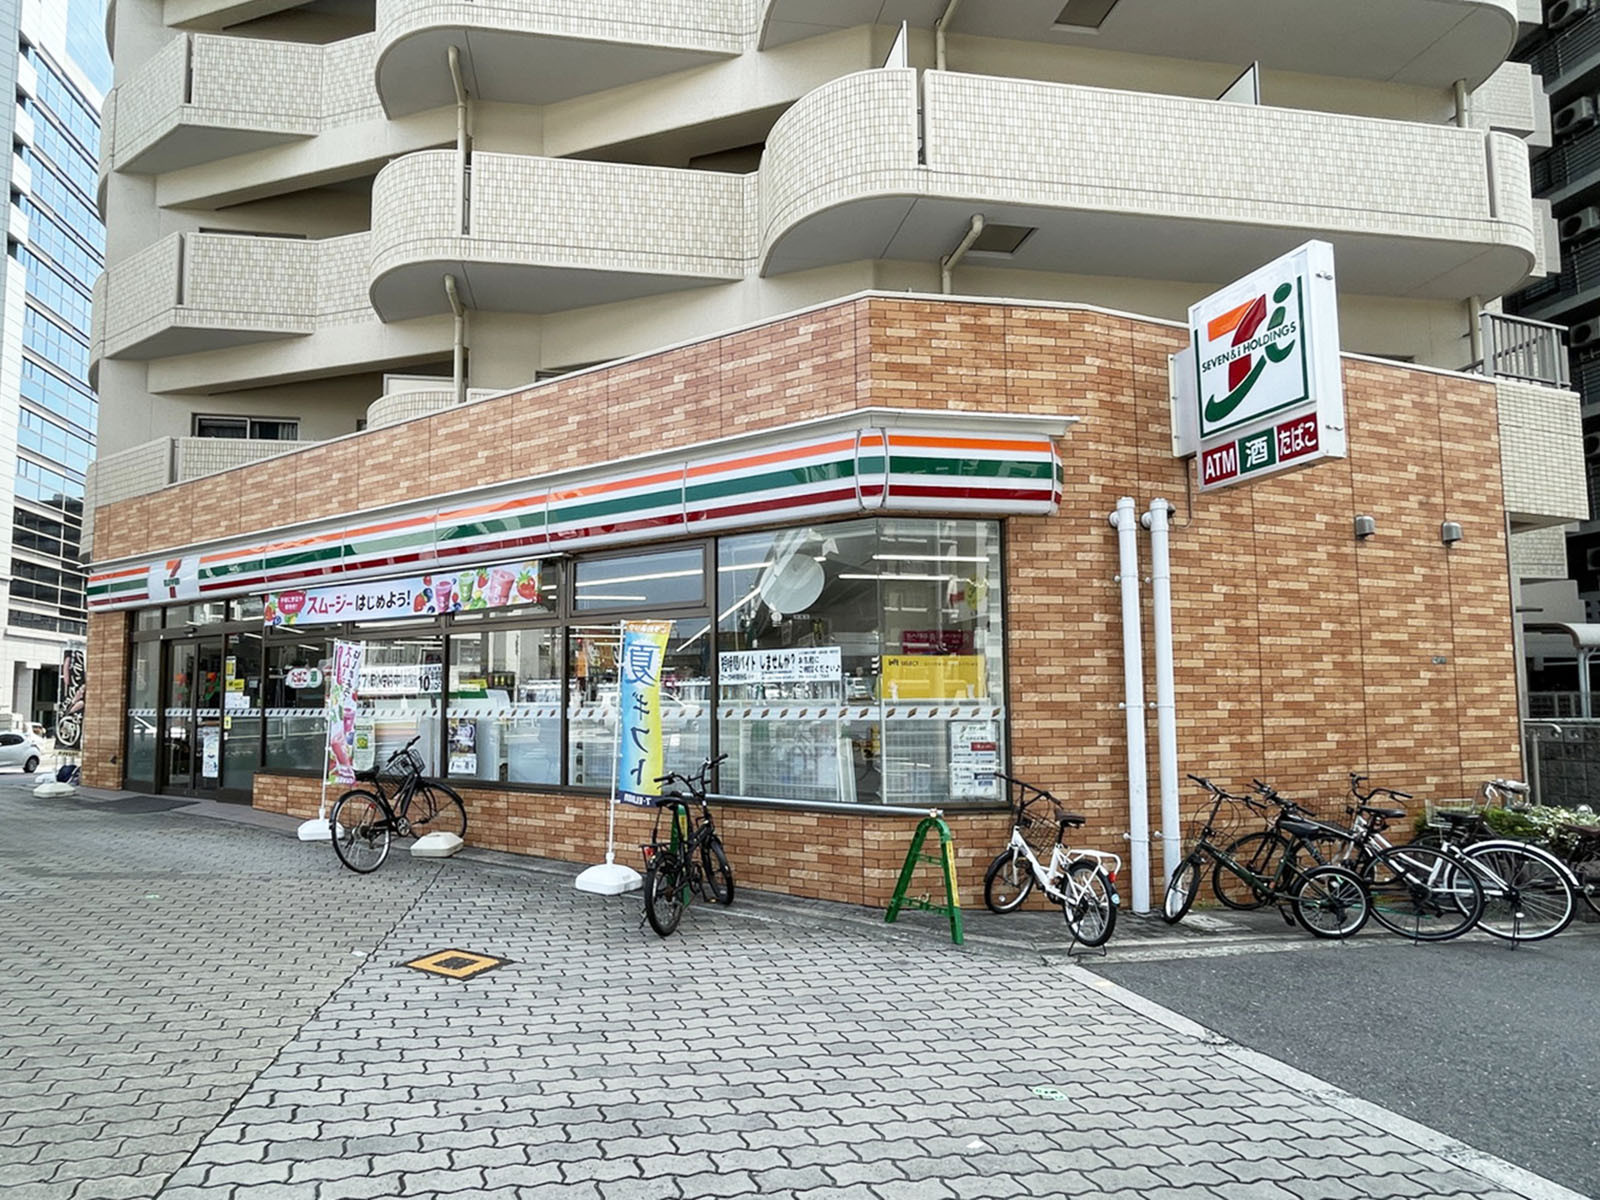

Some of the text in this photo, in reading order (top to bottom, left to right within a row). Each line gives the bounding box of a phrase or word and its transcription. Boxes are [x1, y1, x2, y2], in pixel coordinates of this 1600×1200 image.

[1243, 321, 1297, 354] HOLDINGS
[1245, 436, 1268, 468] 酒
[1279, 421, 1317, 456] たばこ
[1205, 448, 1236, 480] ATM
[306, 594, 353, 615] スムージー
